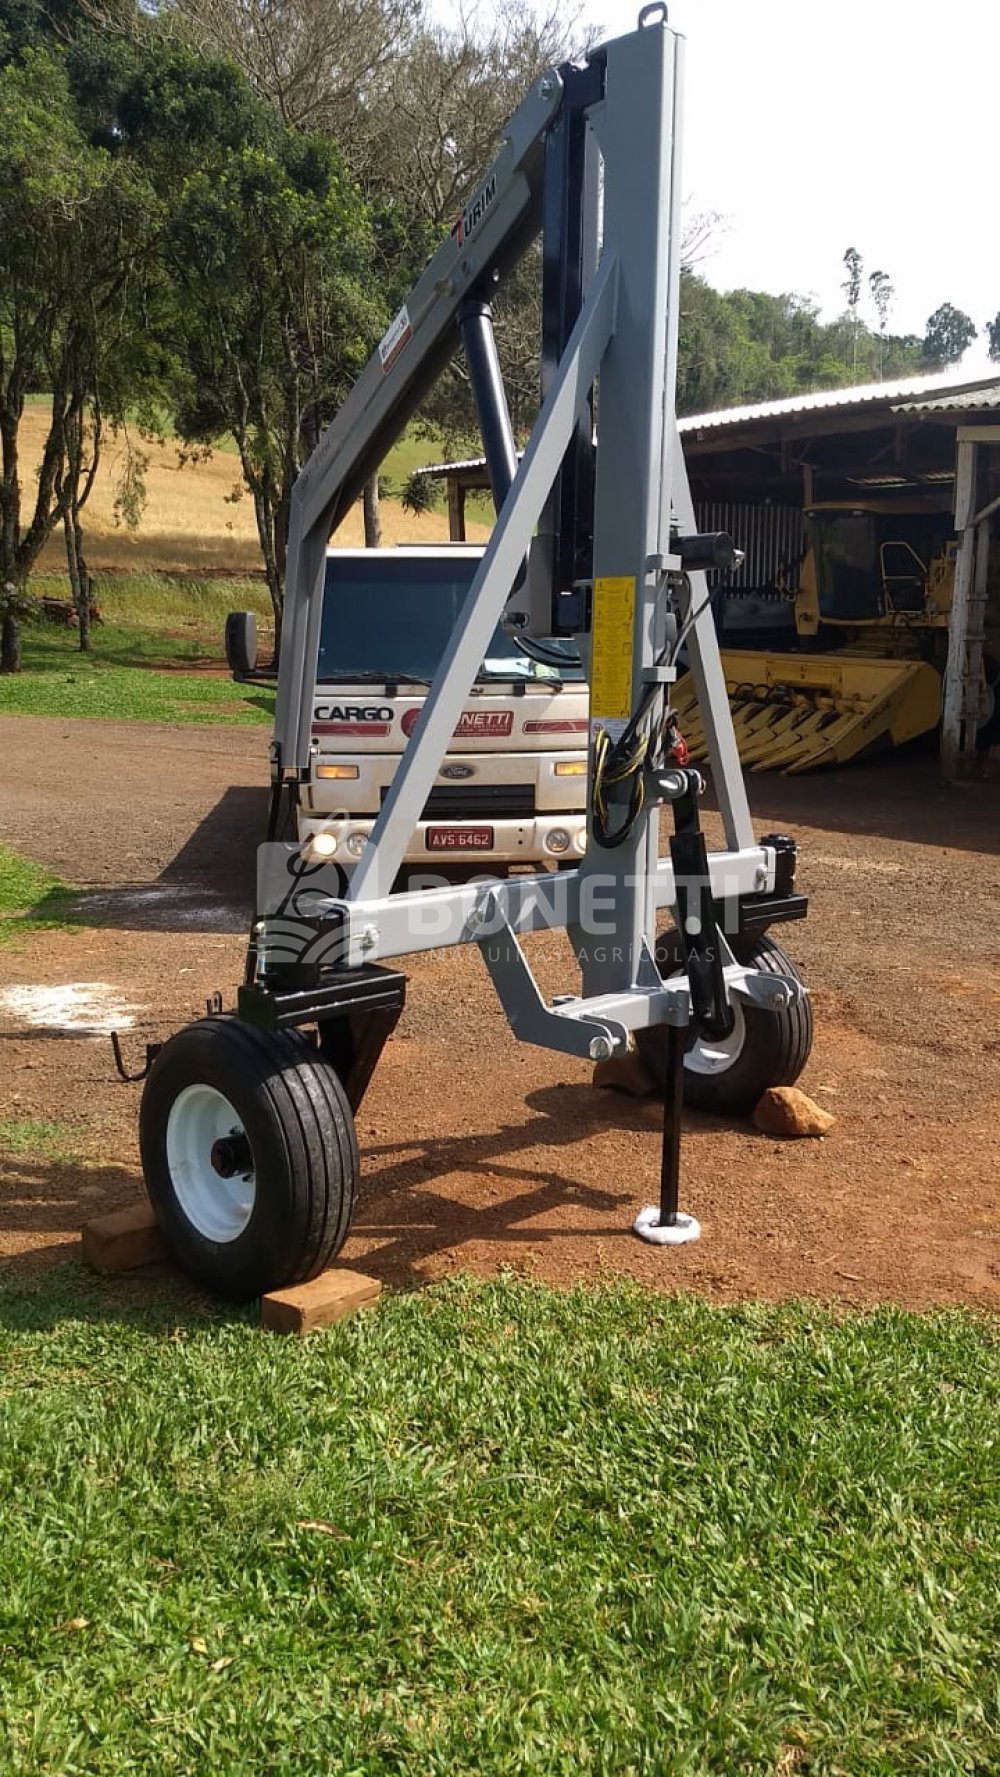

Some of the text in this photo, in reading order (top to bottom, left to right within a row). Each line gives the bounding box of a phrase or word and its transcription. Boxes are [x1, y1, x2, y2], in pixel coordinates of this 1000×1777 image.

[450, 176, 496, 249] TURIM
[314, 706, 394, 721] CARGO
[460, 712, 511, 726] NETTI
[459, 834, 489, 845] 6462
